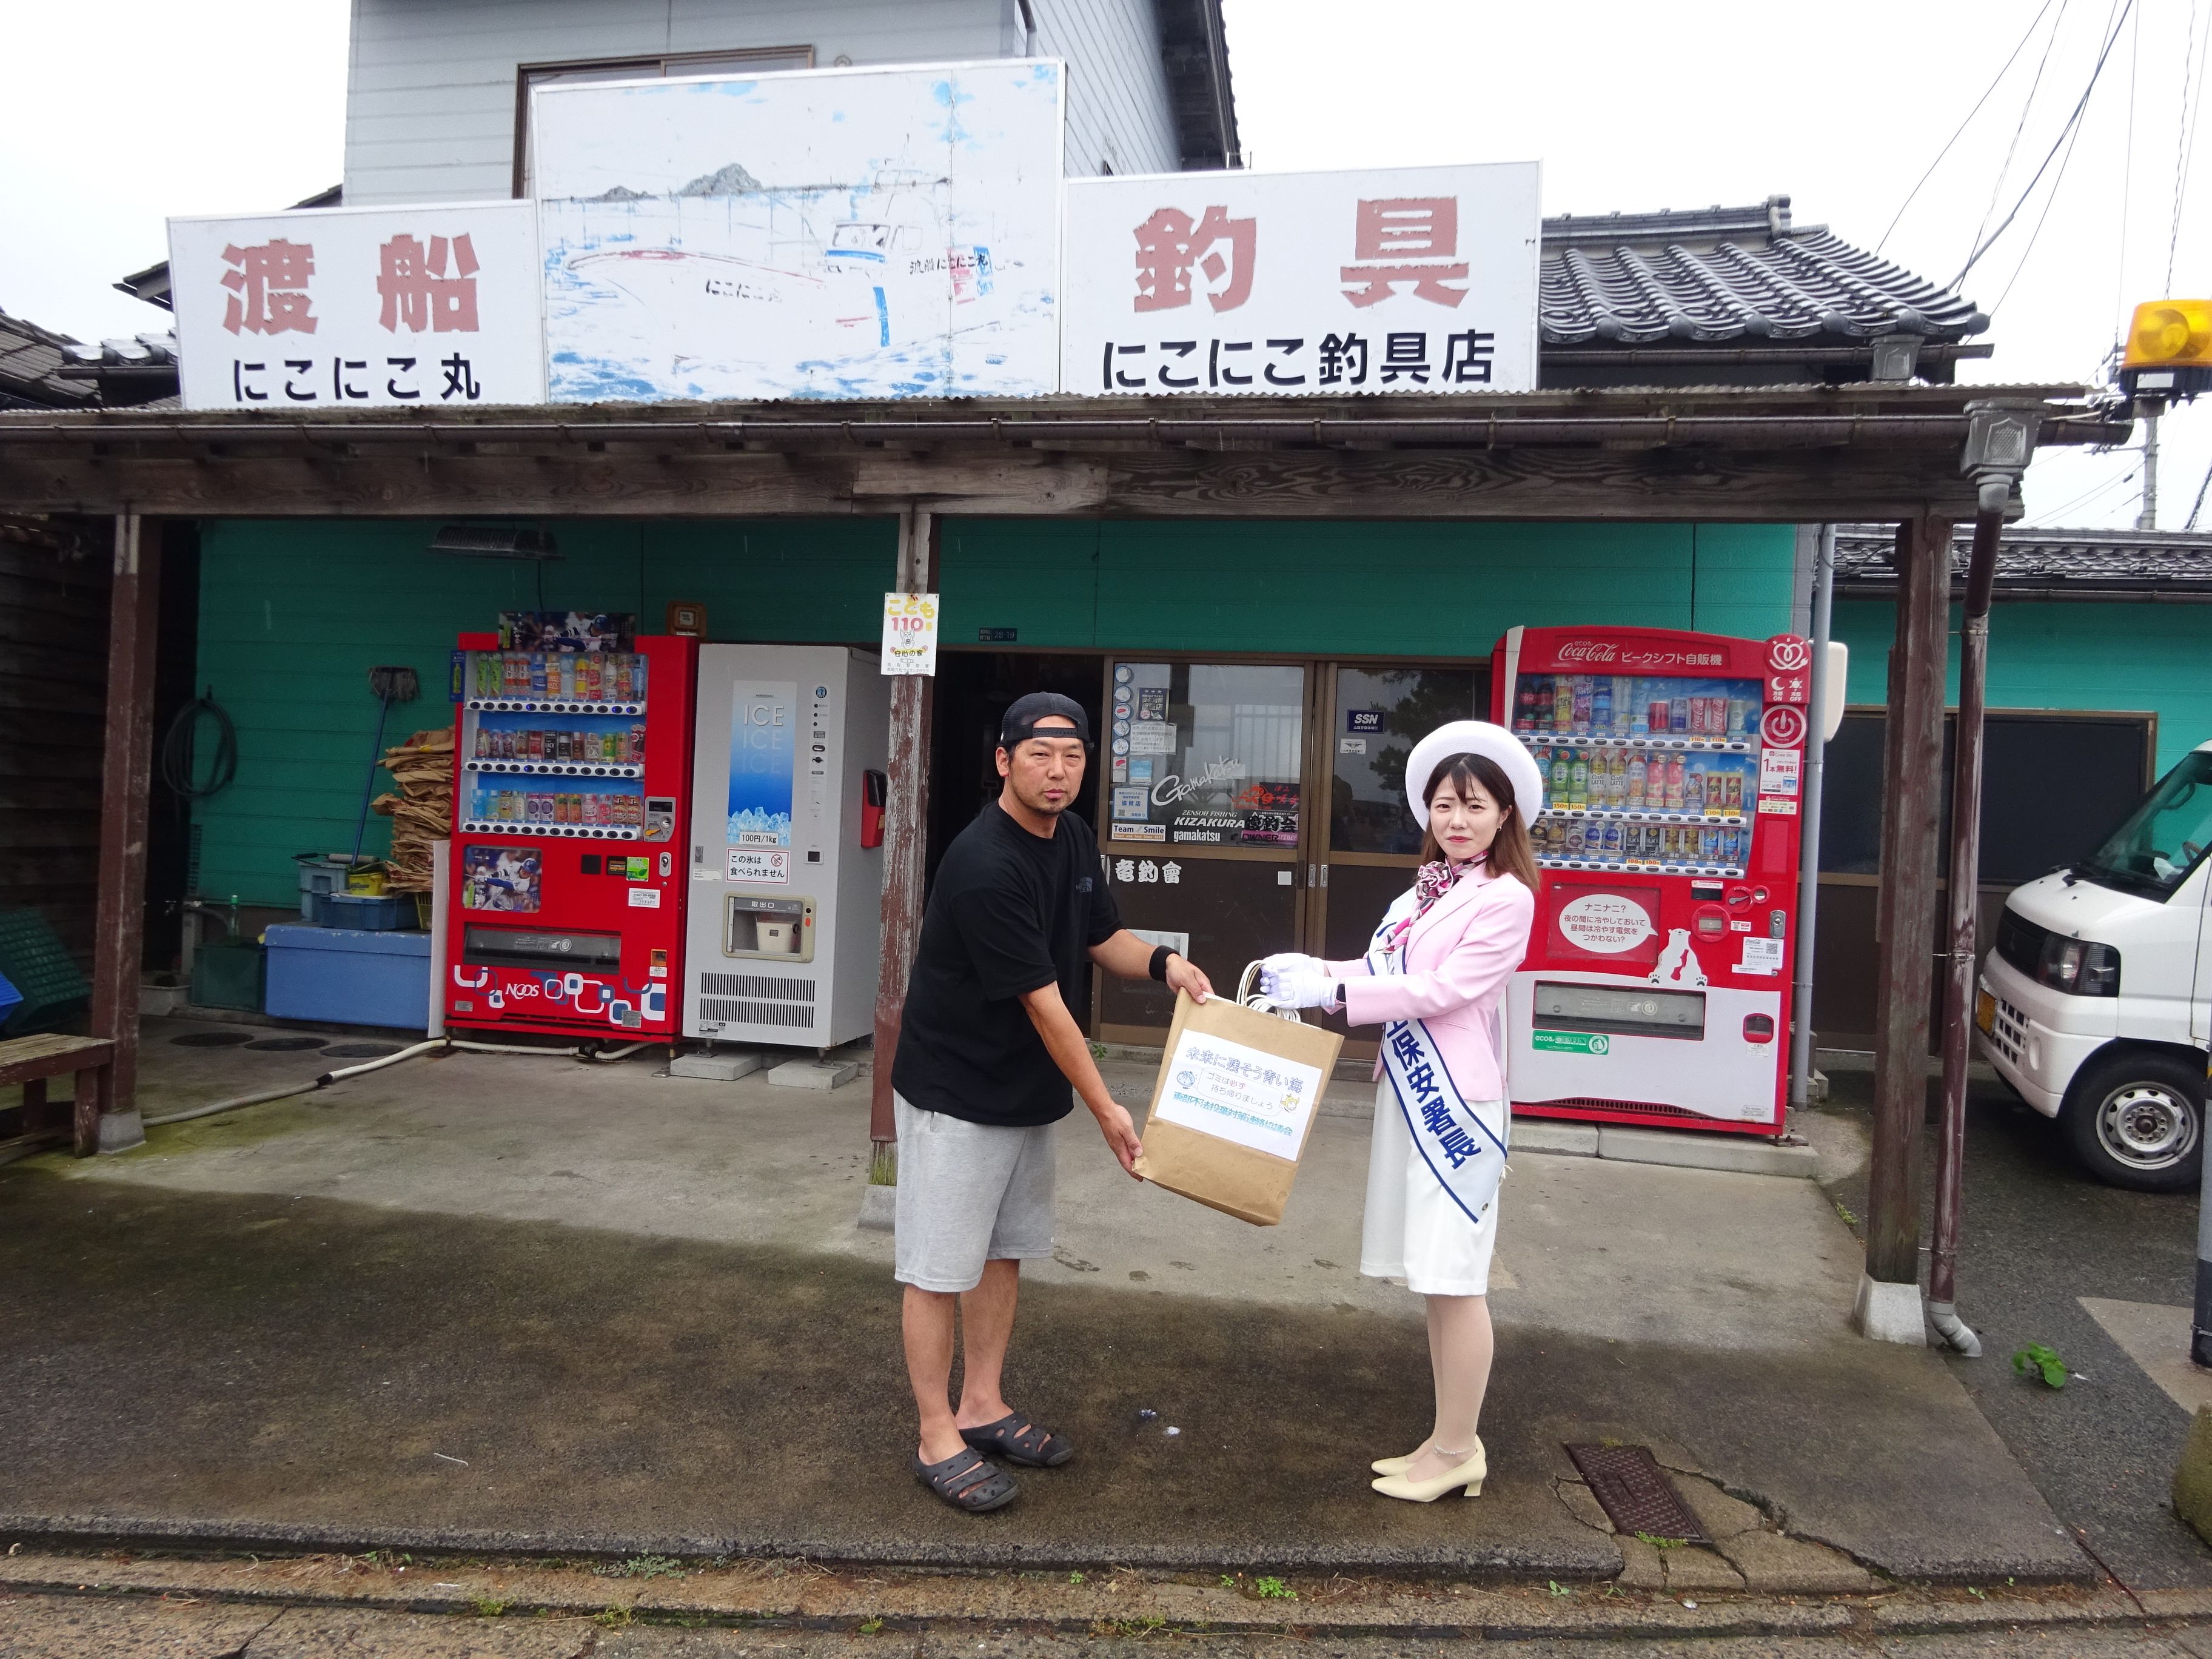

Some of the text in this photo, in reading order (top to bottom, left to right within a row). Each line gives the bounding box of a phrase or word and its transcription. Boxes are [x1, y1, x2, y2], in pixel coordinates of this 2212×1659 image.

[1134, 197, 1470, 312] 釣具
[220, 232, 480, 335] 渡船
[1103, 329, 1495, 390] にこにこ釣具店
[233, 352, 481, 402] にこにこ丸
[887, 595, 936, 619] こども
[1621, 651, 1723, 666] ピークシフト自販機
[743, 704, 785, 726] ICE
[1354, 714, 1378, 725] SSN
[1174, 817, 1245, 829] KIZAKURA
[742, 834, 777, 844] 100円/1kg
[1173, 830, 1221, 842] gamakatsu
[1241, 833, 1279, 842] OWNER
[731, 856, 762, 865] この氷は
[730, 867, 785, 878] 食べられません
[1584, 903, 1627, 913] ナニナニ?
[1564, 914, 1646, 927] 夜の間に冷やしておいて
[1570, 923, 1638, 936] 昼間は冷やす電気を
[1583, 934, 1626, 943] つかわない?
[1185, 1046, 1304, 1094] 未来に残そう青い海
[1206, 1071, 1247, 1090] ゴミは必ず
[1211, 1084, 1274, 1110] 持ち帰りましょう
[1173, 1091, 1294, 1137] 東部不法投棄対策連絡協議会
